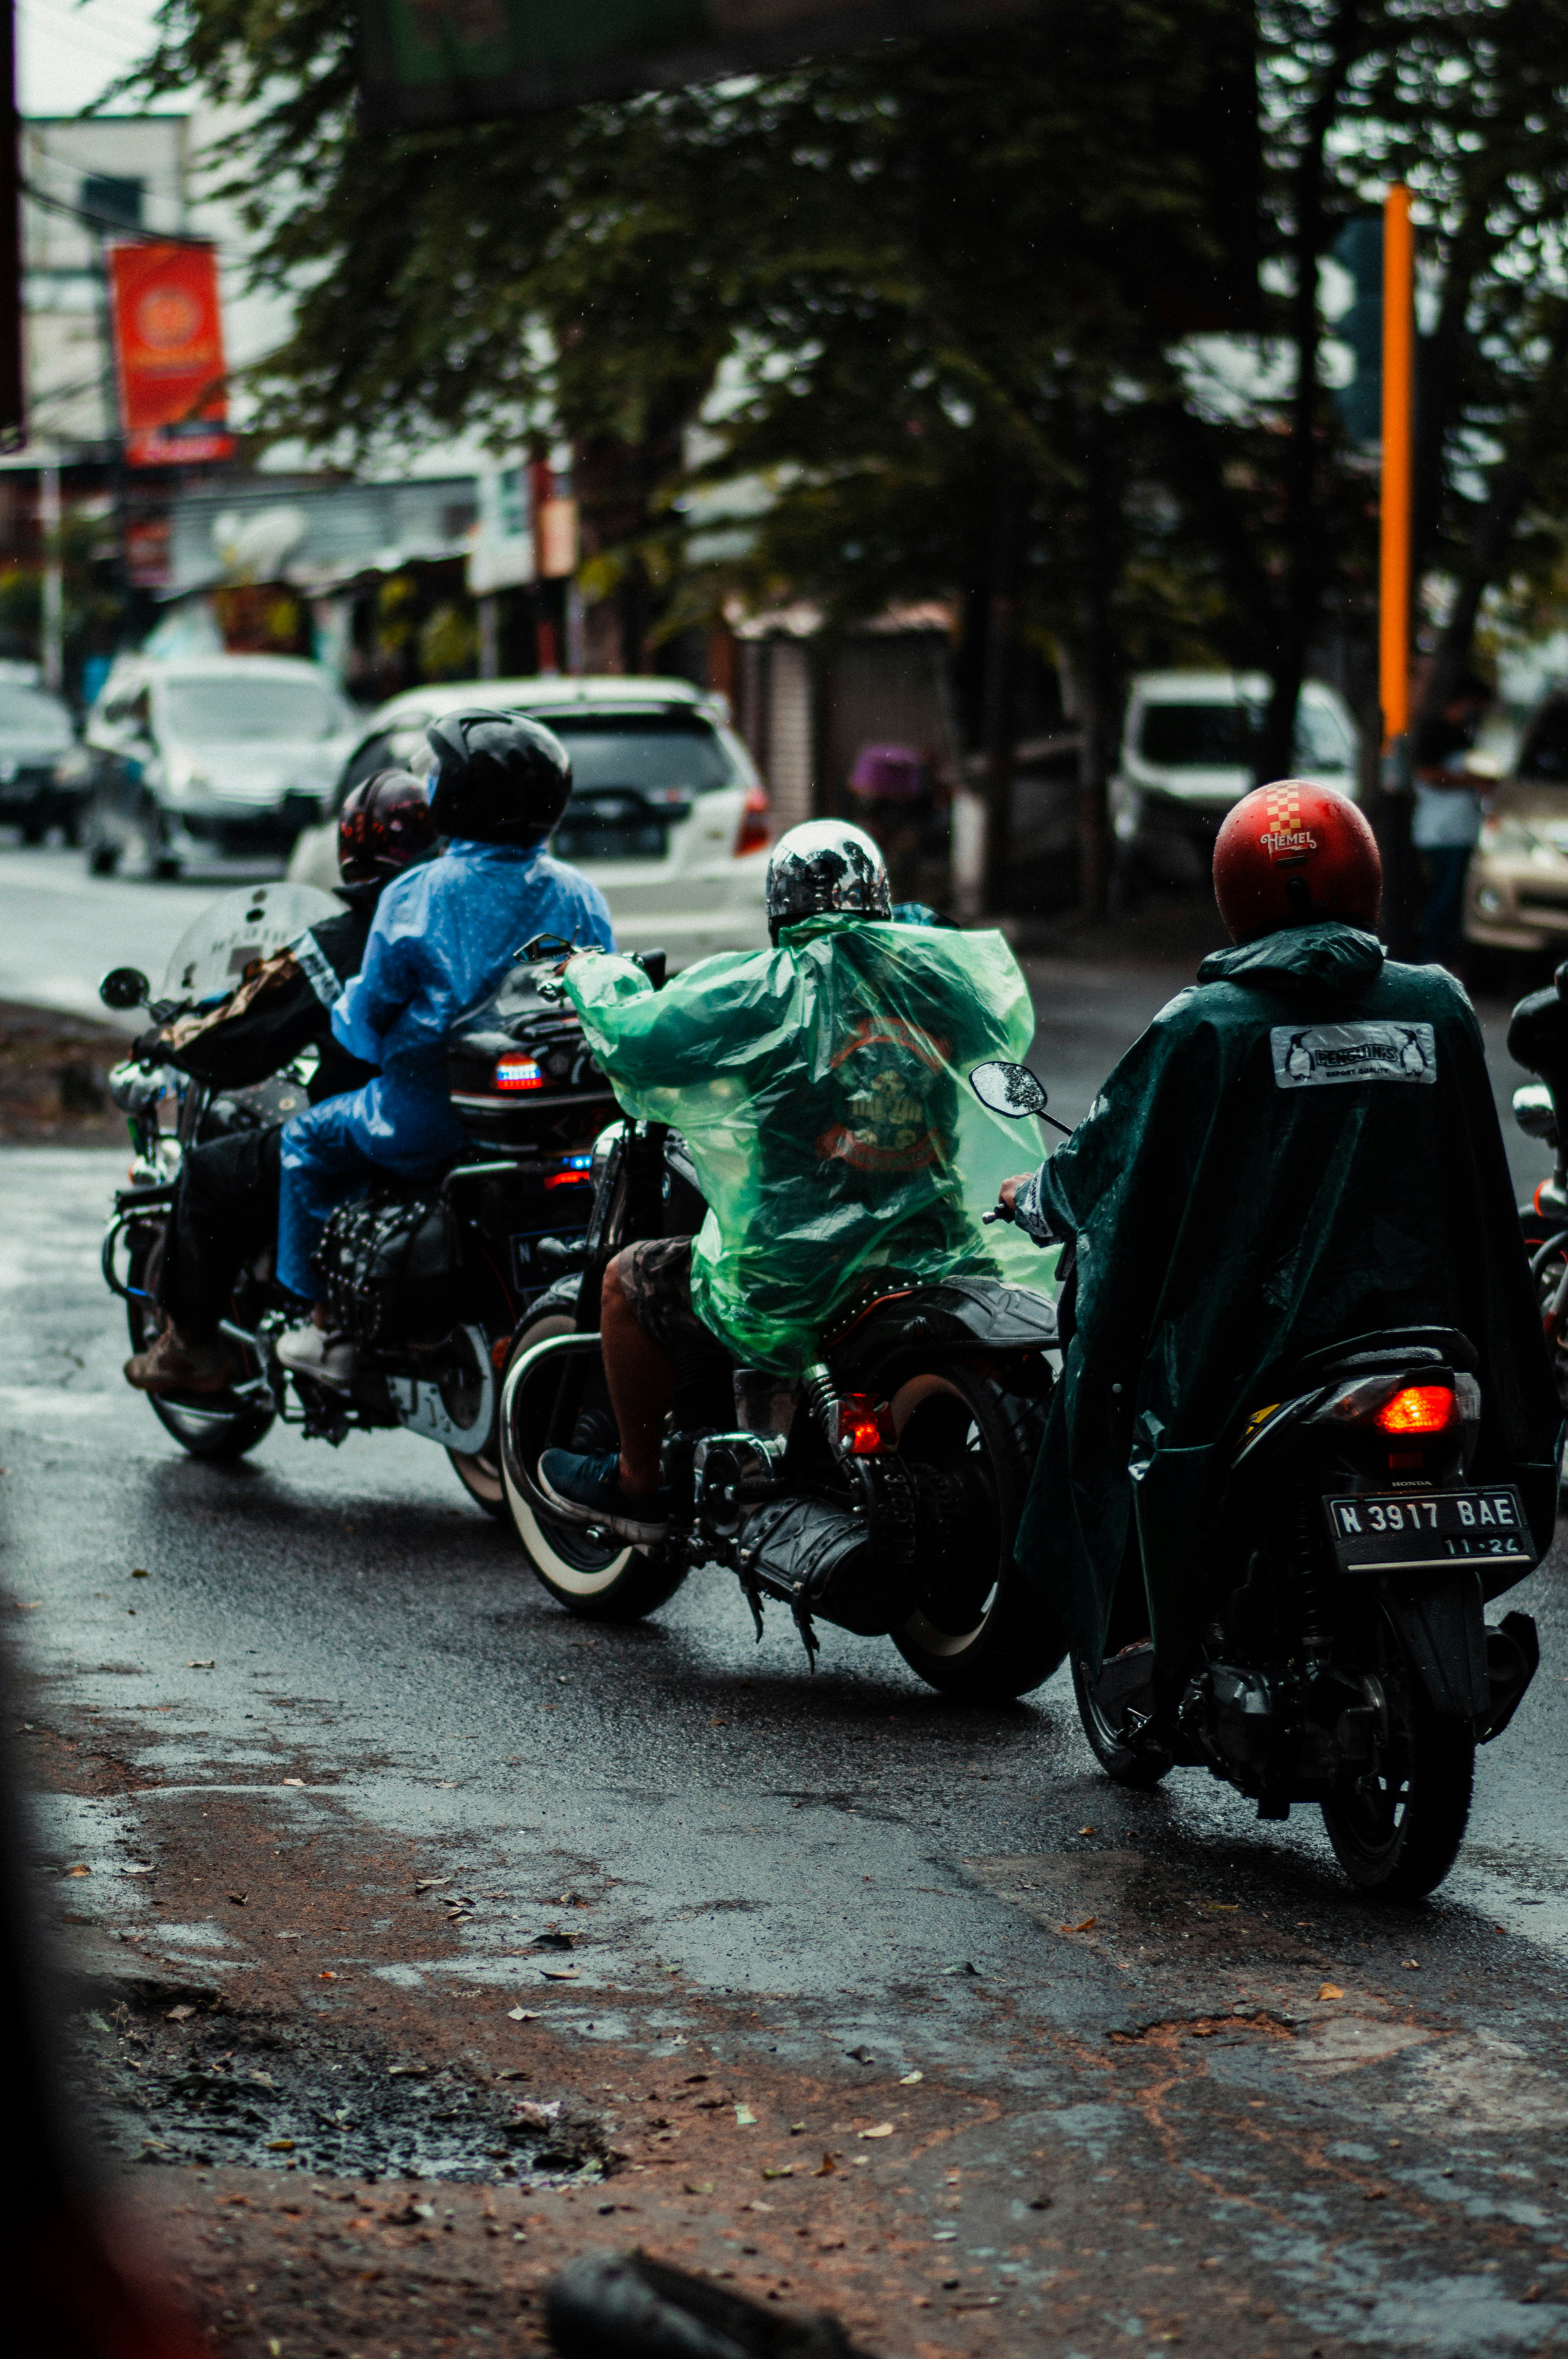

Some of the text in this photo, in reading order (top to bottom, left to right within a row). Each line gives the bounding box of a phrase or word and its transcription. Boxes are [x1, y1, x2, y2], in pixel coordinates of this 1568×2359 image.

[1260, 832, 1317, 859] HEMEL
[519, 1241, 531, 1264] N
[1340, 1499, 1514, 1533] N 3917 BAE
